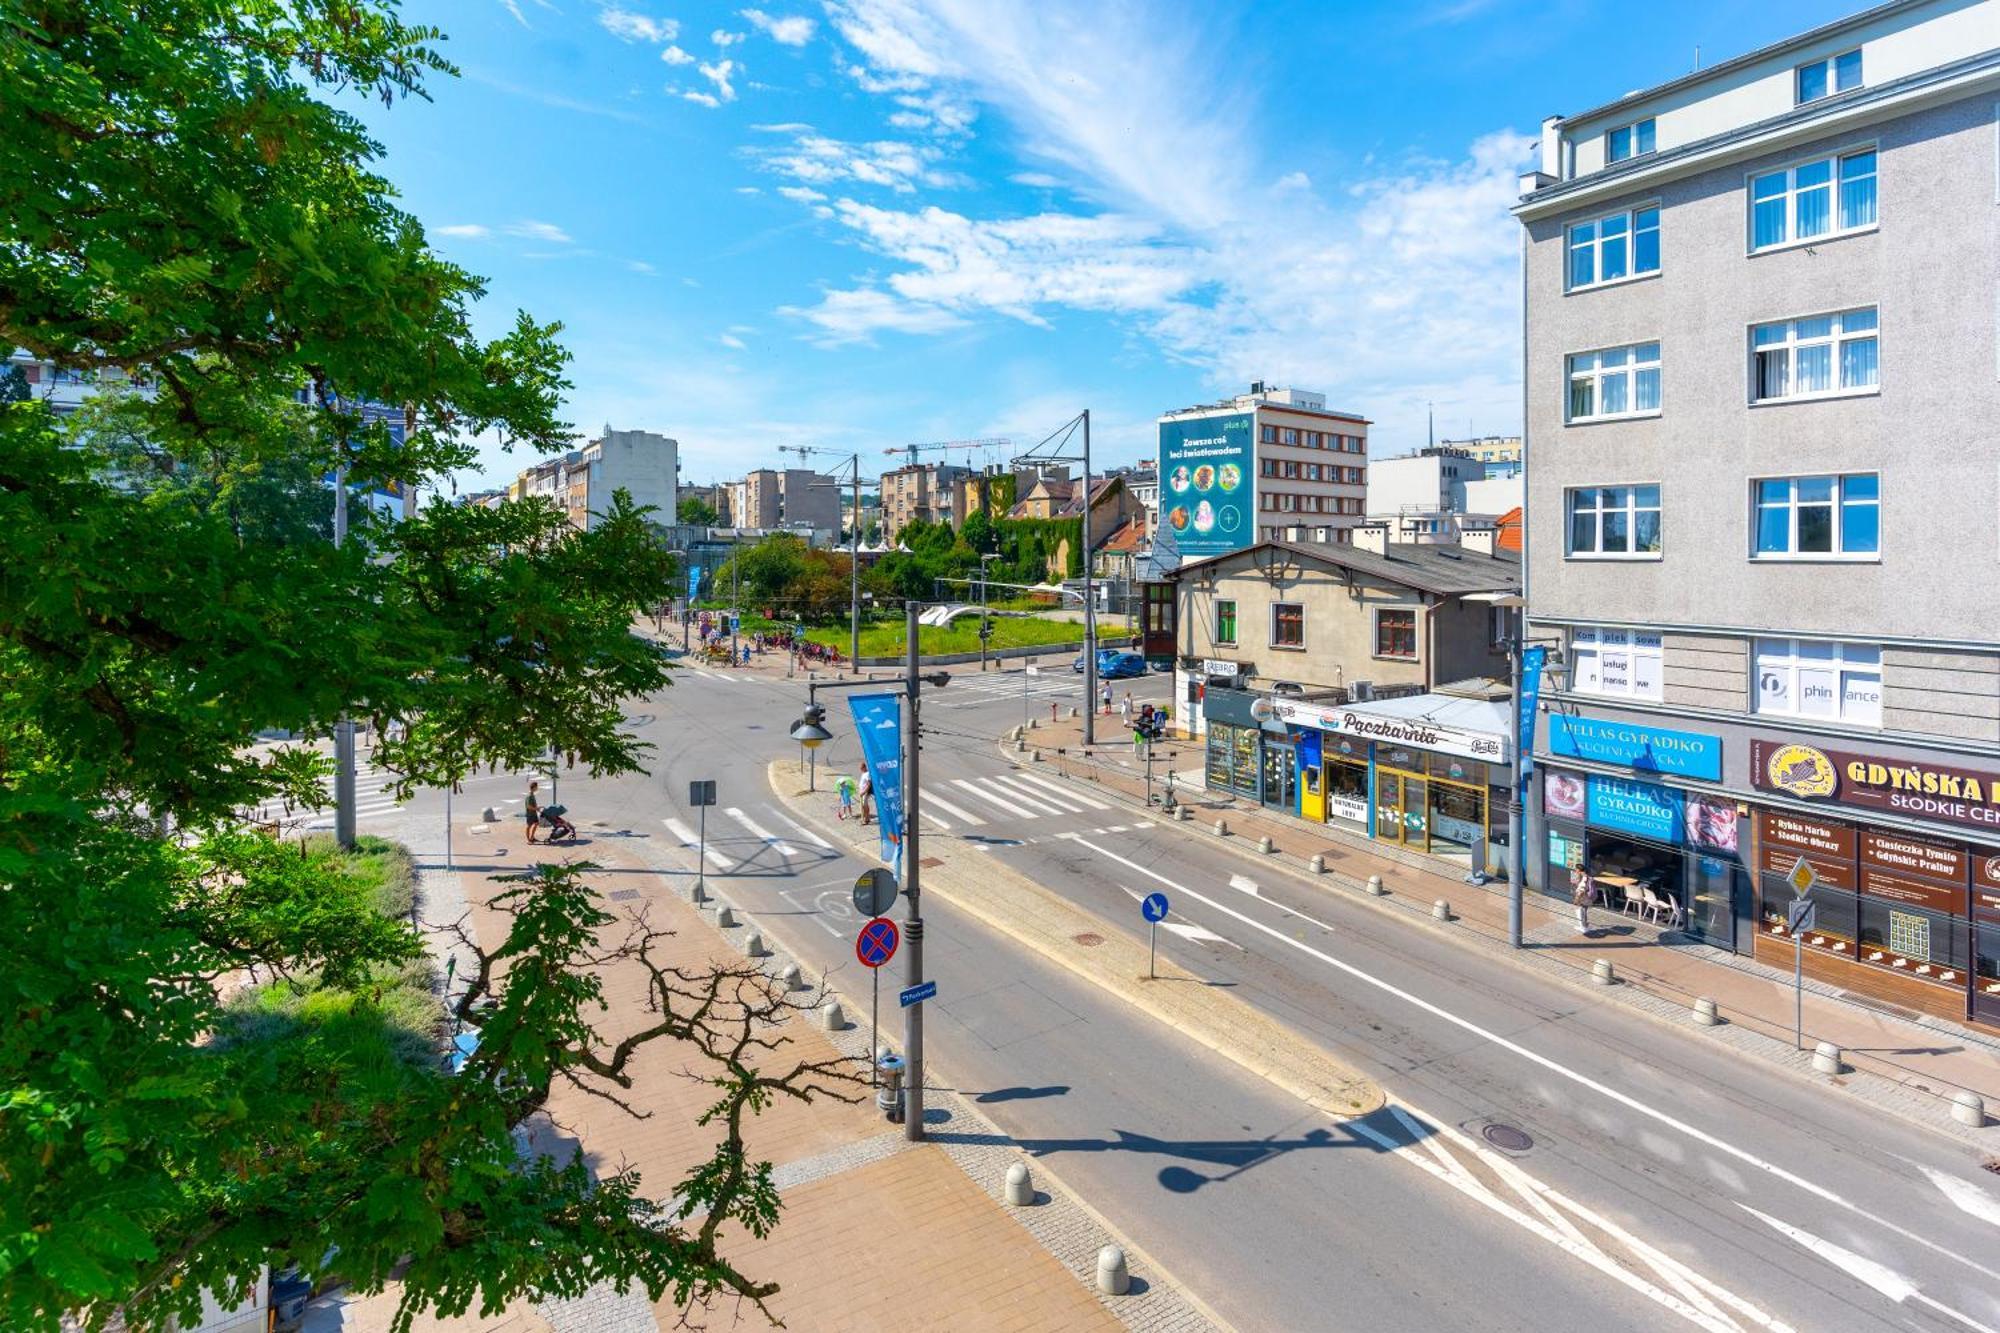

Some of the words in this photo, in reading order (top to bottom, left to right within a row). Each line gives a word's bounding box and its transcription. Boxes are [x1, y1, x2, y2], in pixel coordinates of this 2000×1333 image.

[1206, 662, 1236, 673] SREBRO
[1344, 712, 1440, 745] Pączkarnia
[1562, 722, 1616, 740] HELLAS
[1618, 730, 1705, 753] GYRADIKO
[1633, 750, 1685, 767] GCKA
[1597, 778, 1674, 805] HELLAS
[1847, 761, 1984, 802] GDYŃSKA
[1596, 796, 1673, 819] GYRADIKO
[1890, 794, 1966, 818] SŁODKIE
[1919, 858, 1956, 875] Praliny
